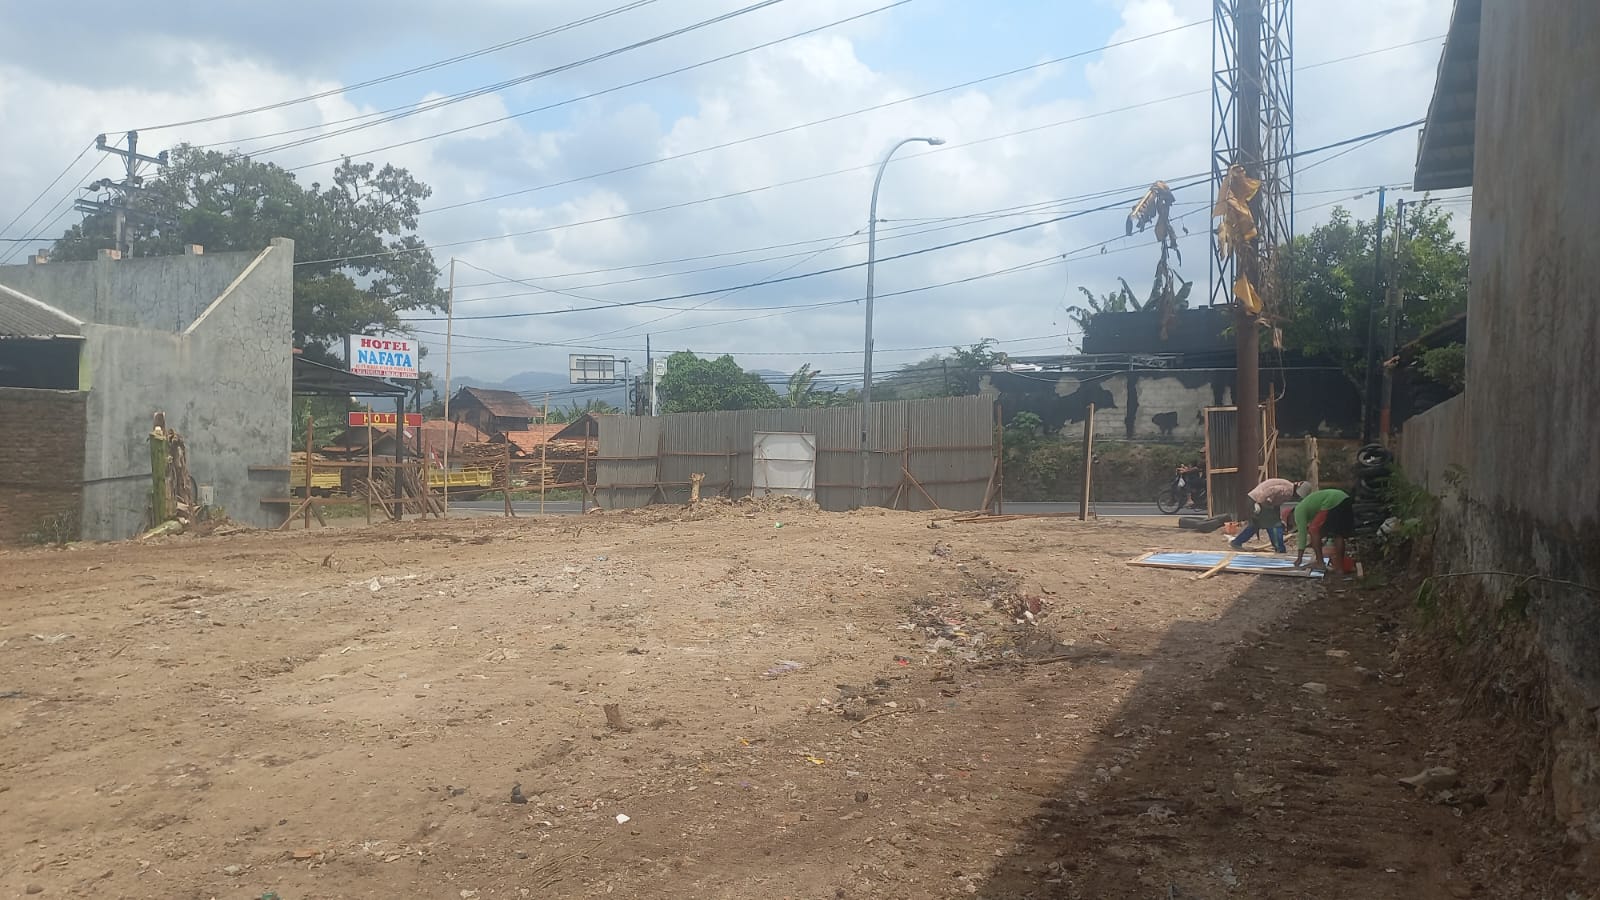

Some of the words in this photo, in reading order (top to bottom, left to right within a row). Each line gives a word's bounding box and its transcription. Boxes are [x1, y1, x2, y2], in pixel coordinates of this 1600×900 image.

[361, 338, 410, 351] HOTEL
[357, 350, 412, 367] NAFATA
[363, 414, 409, 423] HOTL
